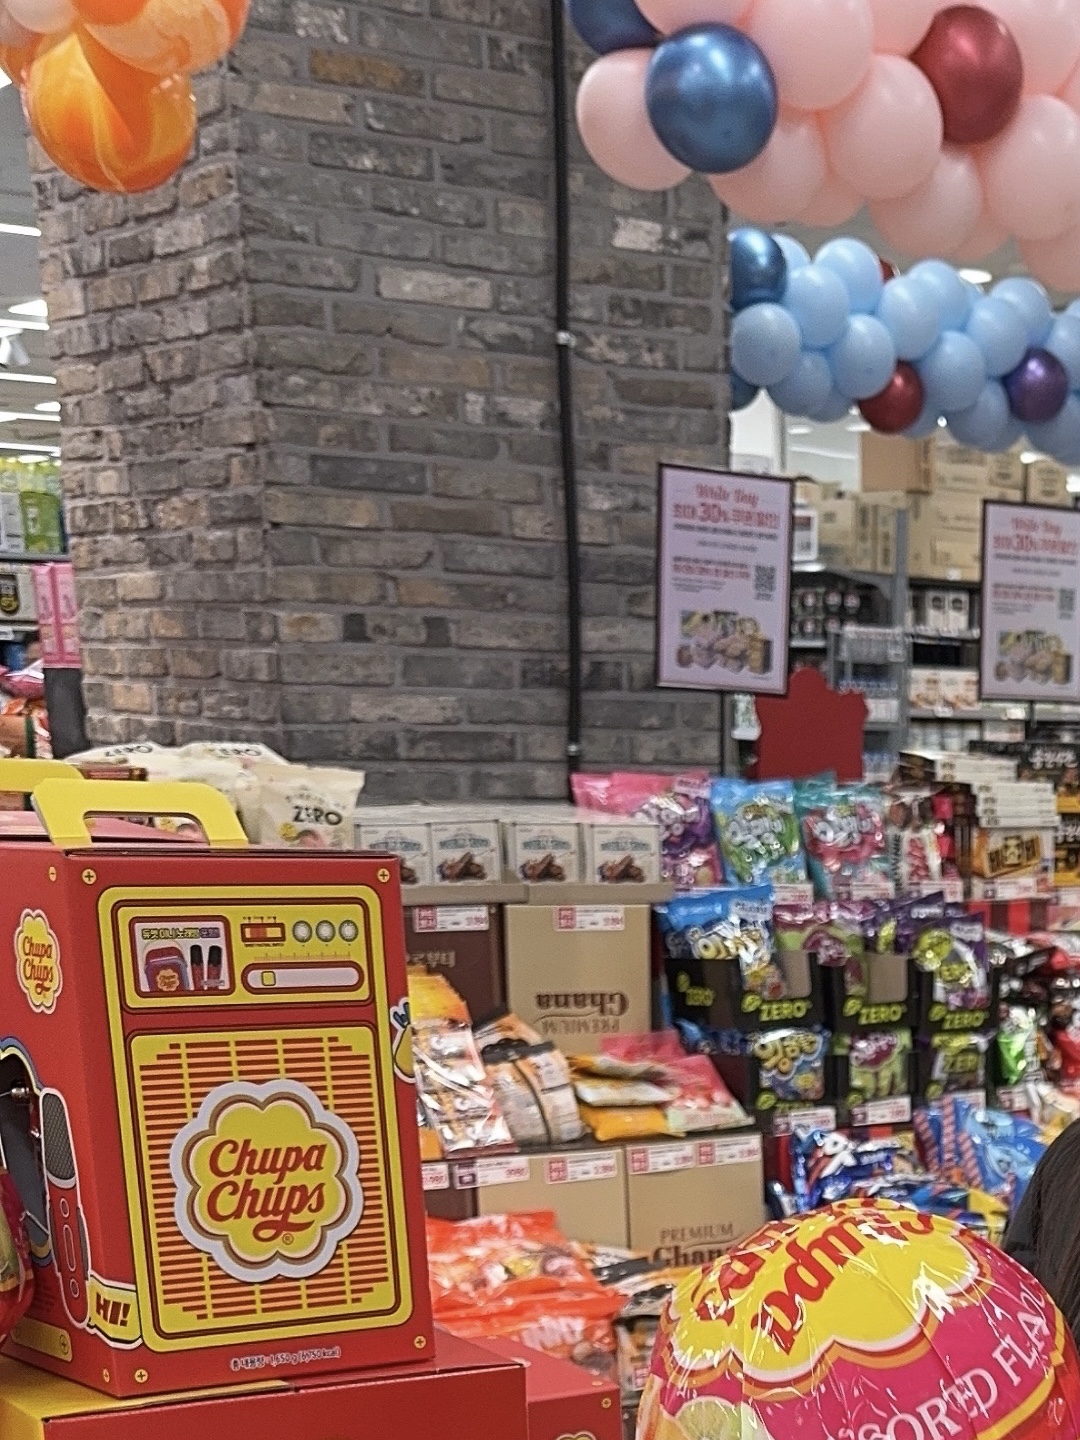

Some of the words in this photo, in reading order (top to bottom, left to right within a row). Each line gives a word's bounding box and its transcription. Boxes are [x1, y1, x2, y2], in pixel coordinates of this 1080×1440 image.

[23, 936, 52, 963] Chupa
[23, 958, 54, 995] Chups
[535, 991, 629, 1017] Ghana
[758, 999, 813, 1022] ZERO
[858, 1002, 907, 1025] ZERO
[942, 1010, 989, 1030] ZERO
[209, 1138, 327, 1185] Chupa
[207, 1178, 326, 1242] Chups
[660, 1222, 733, 1245] PREMIUM
[95, 1291, 132, 1327] HI!
